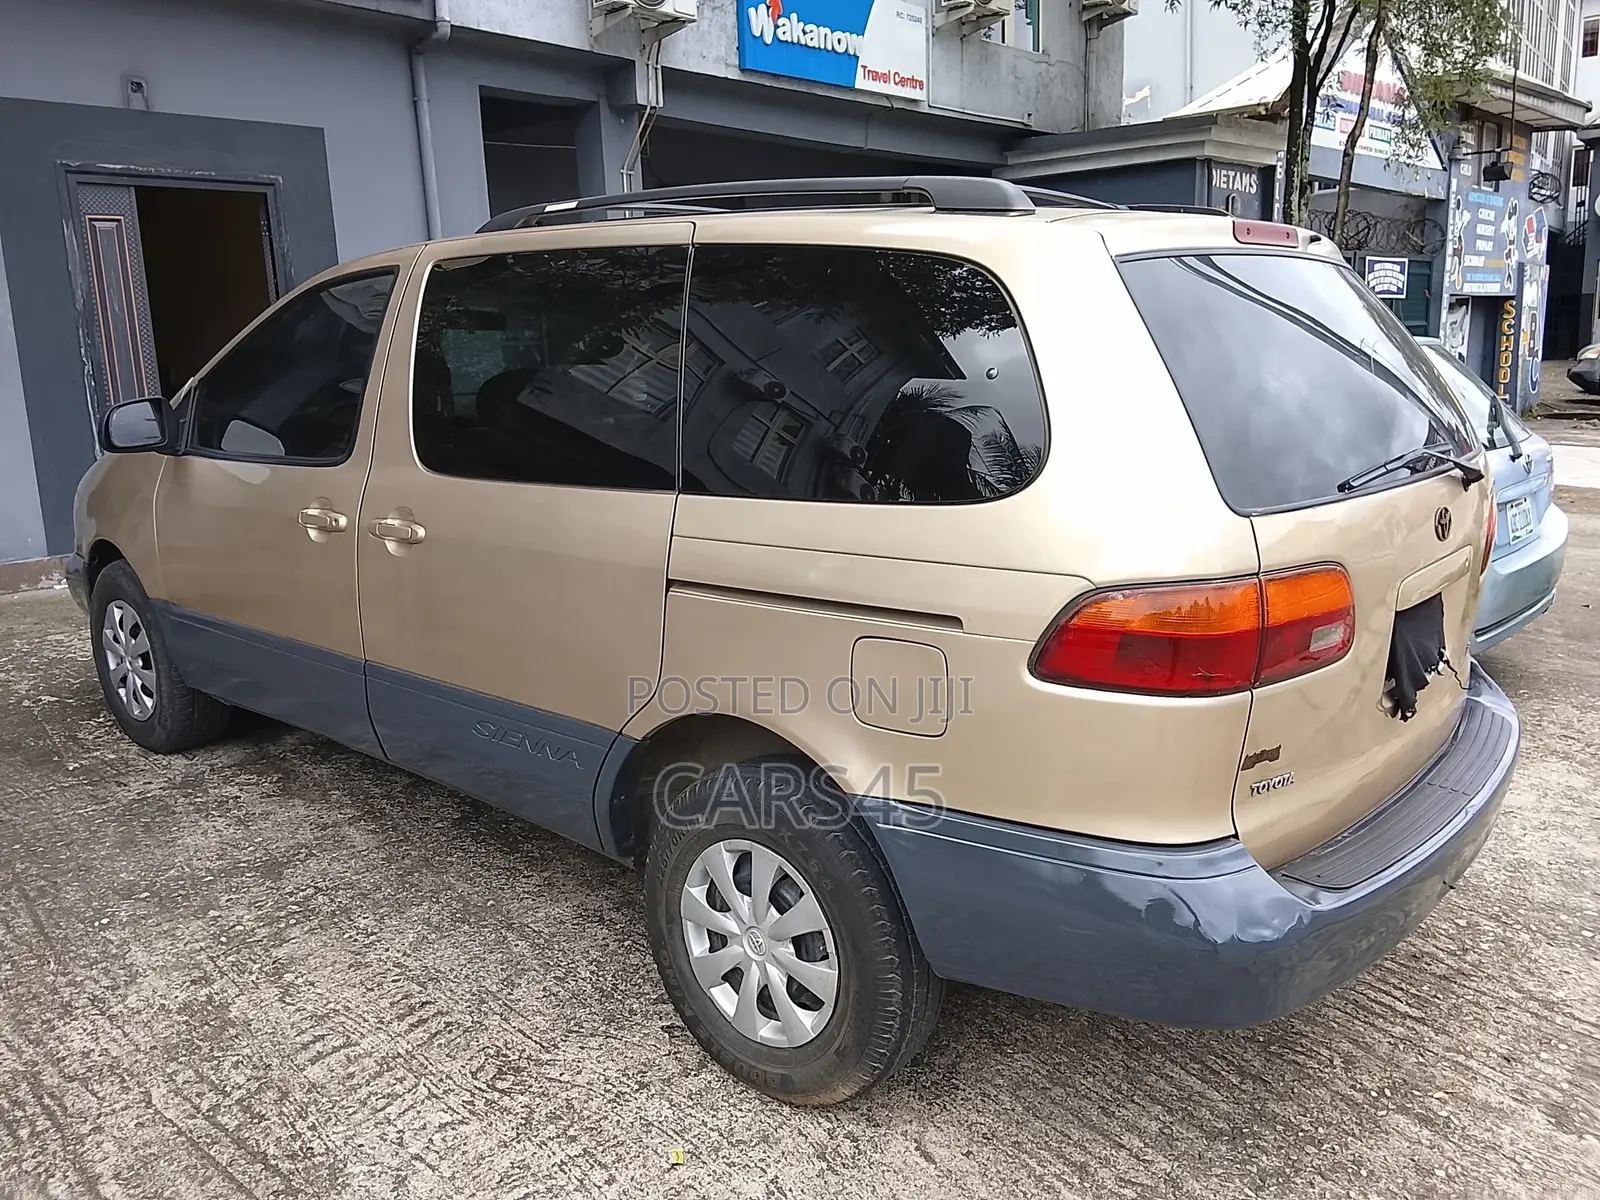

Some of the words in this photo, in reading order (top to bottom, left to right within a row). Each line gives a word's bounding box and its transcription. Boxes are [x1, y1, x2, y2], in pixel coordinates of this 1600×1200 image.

[748, 3, 864, 56] Wakanow
[861, 65, 891, 85] Travel
[893, 71, 925, 91] Centre
[1499, 299, 1517, 401] SCHOOL
[471, 720, 584, 770] SIENNA
[1250, 771, 1295, 797] TOYOTA
